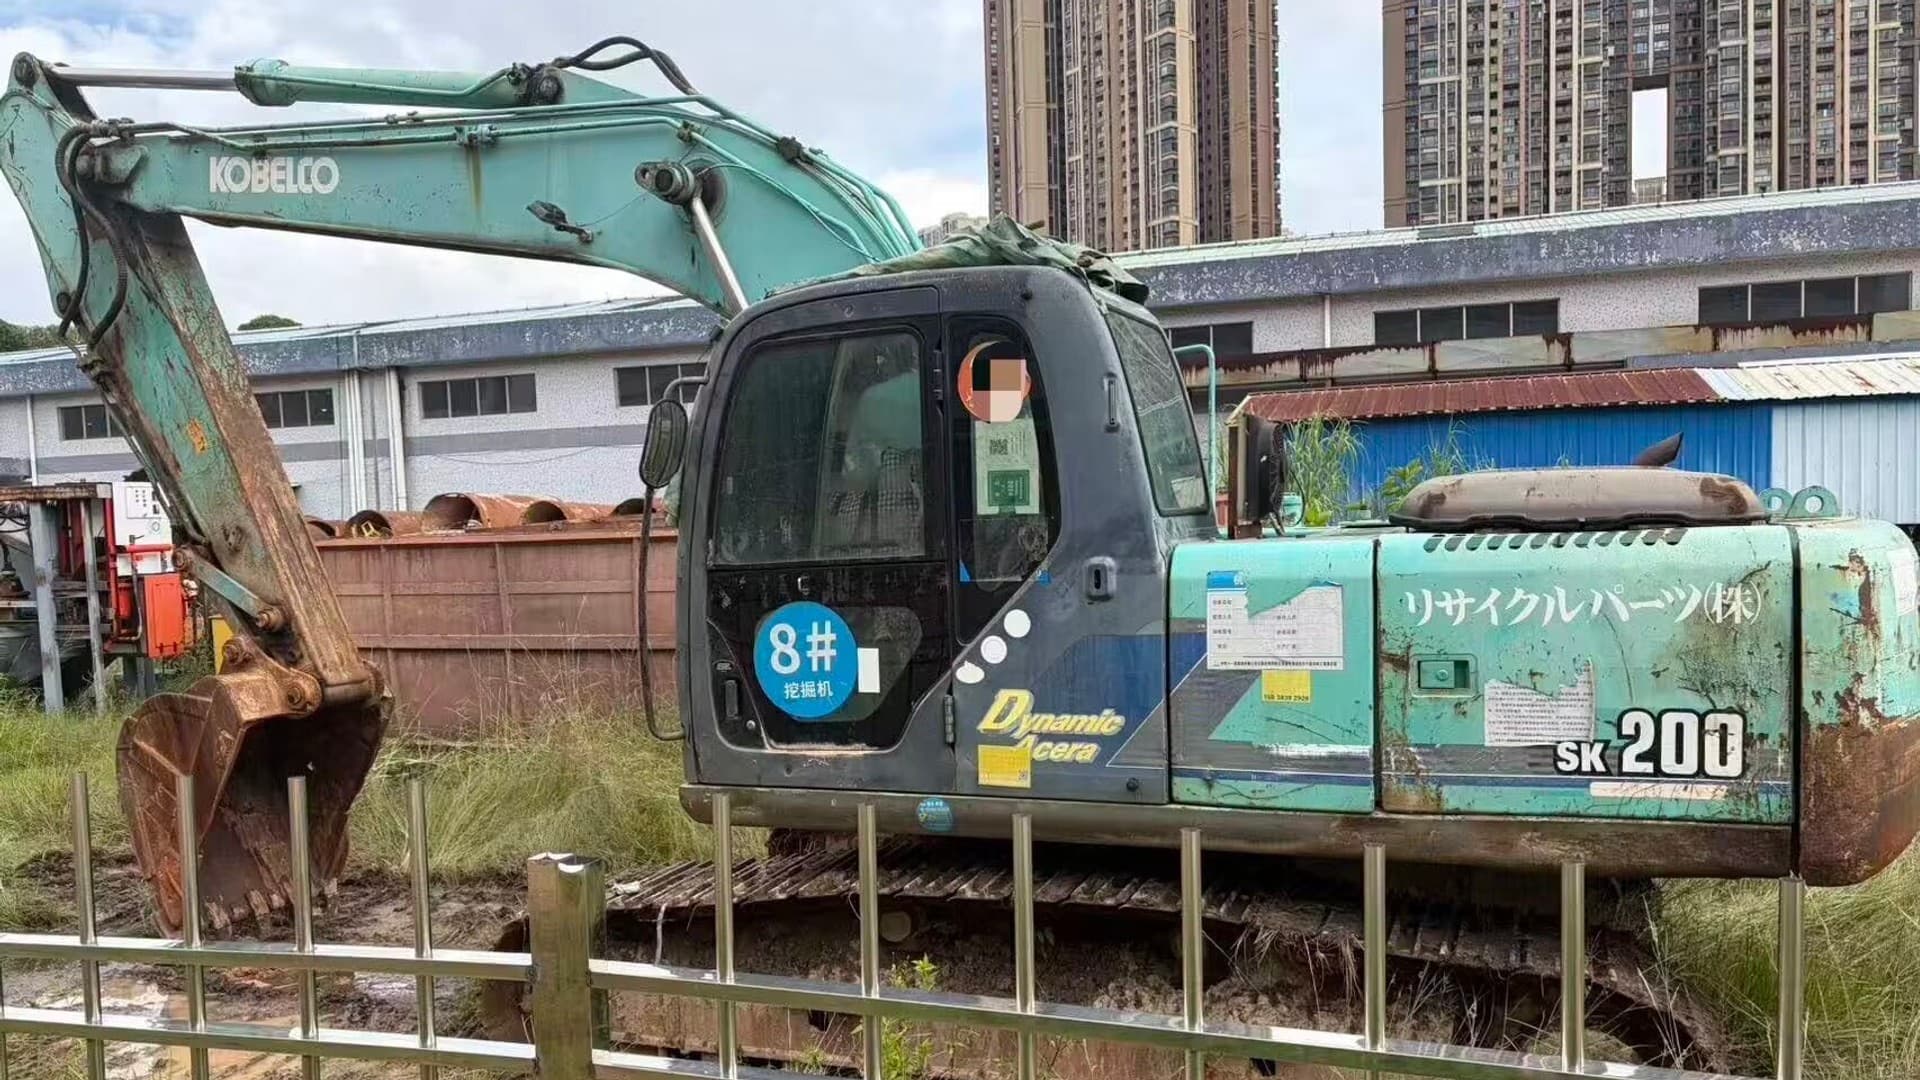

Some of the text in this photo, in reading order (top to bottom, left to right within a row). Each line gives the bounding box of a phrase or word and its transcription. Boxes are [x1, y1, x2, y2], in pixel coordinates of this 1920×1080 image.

[209, 156, 340, 194] KOBELCO
[769, 620, 837, 675] 8#
[784, 680, 834, 699] 挖掘机
[977, 688, 1126, 739] Dynamic
[1556, 710, 1745, 778] SK 200
